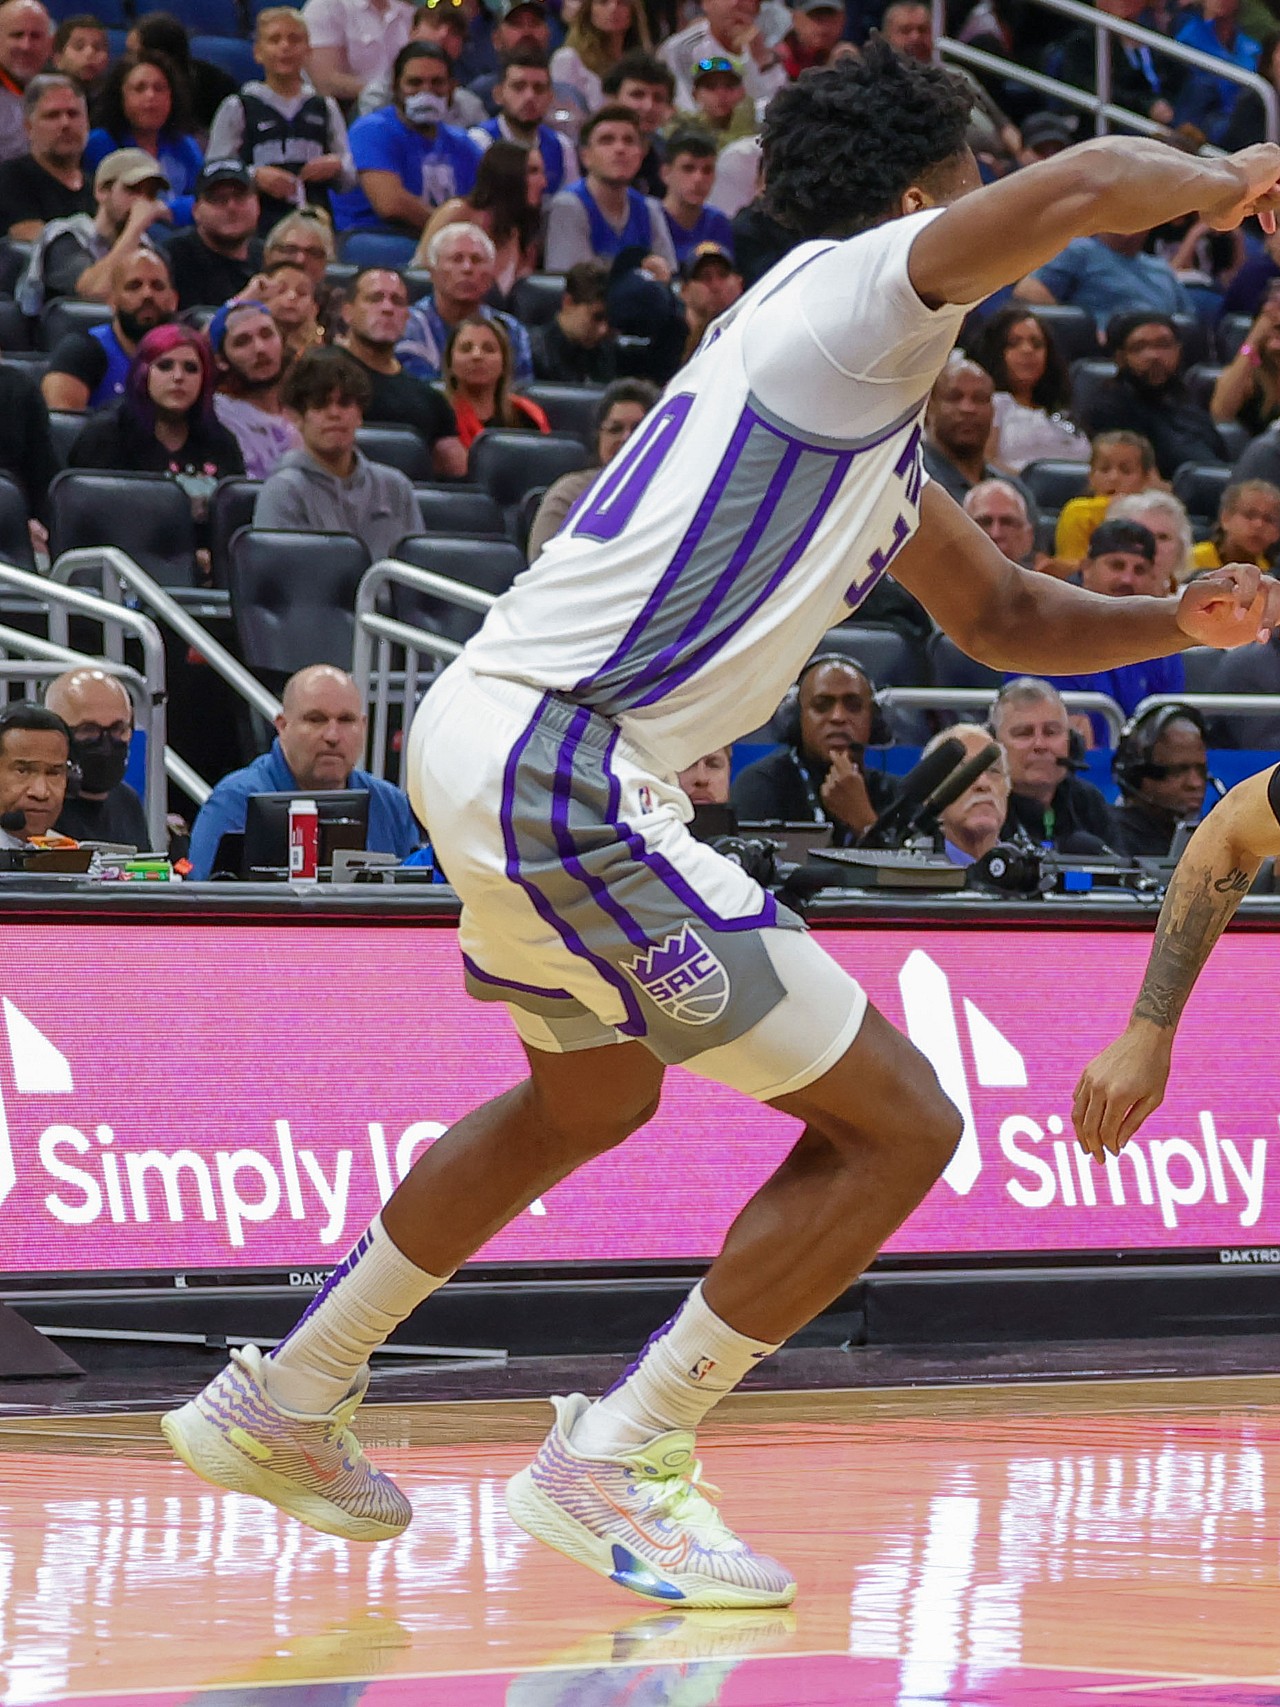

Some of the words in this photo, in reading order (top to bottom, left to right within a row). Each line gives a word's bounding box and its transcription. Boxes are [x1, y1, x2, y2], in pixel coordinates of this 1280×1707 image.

[557, 391, 697, 544] 0
[645, 951, 719, 1003] SAC
[38, 1119, 353, 1246] Simply
[999, 1110, 1267, 1229] Simply
